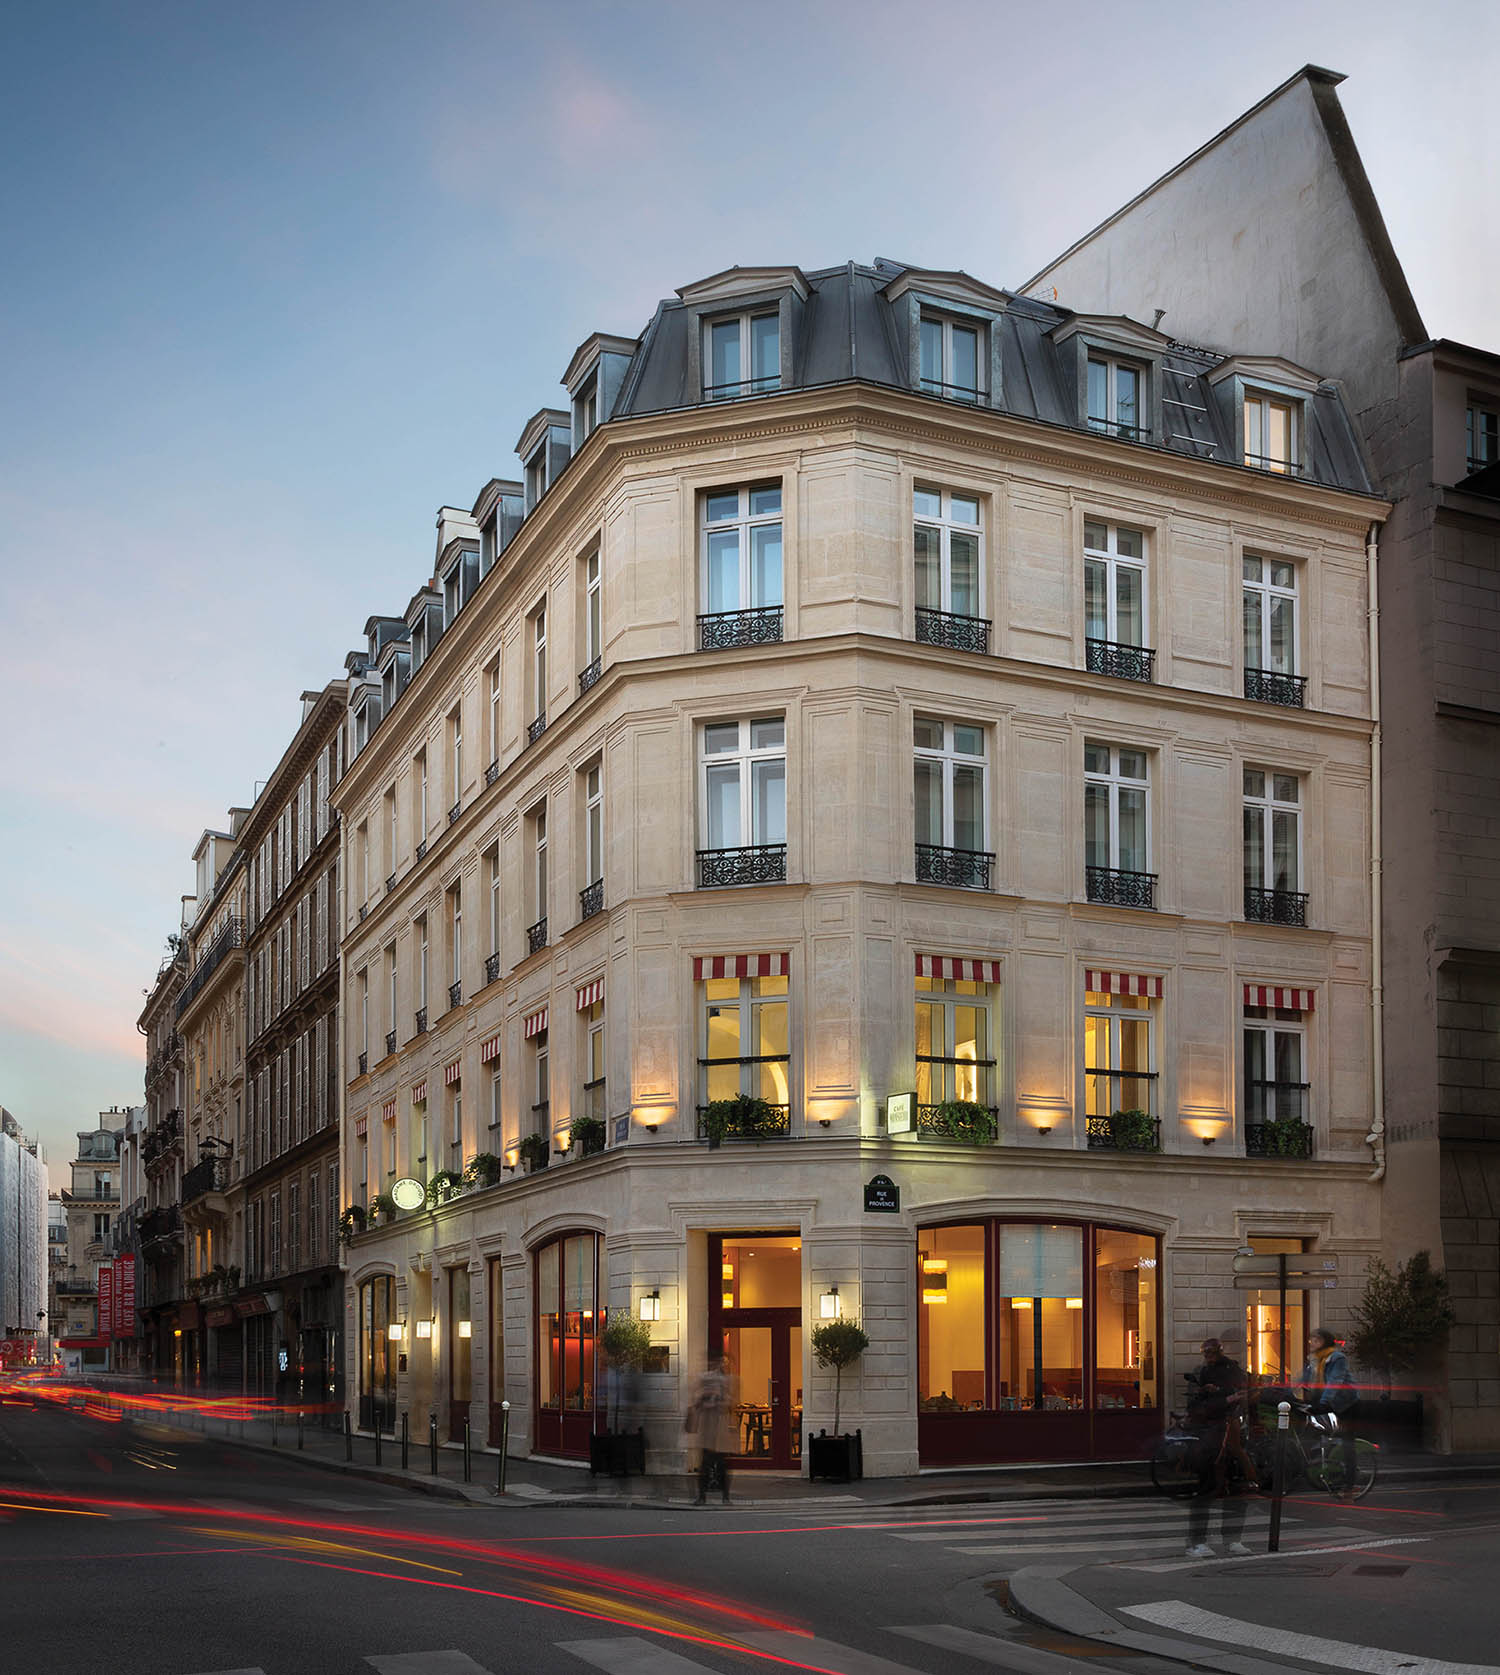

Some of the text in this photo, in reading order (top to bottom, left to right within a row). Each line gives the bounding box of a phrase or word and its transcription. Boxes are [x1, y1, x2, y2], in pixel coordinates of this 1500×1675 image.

[101, 1273, 110, 1297] VENTES
[101, 1299, 110, 1311] DES
[124, 1292, 135, 1306] BAR
